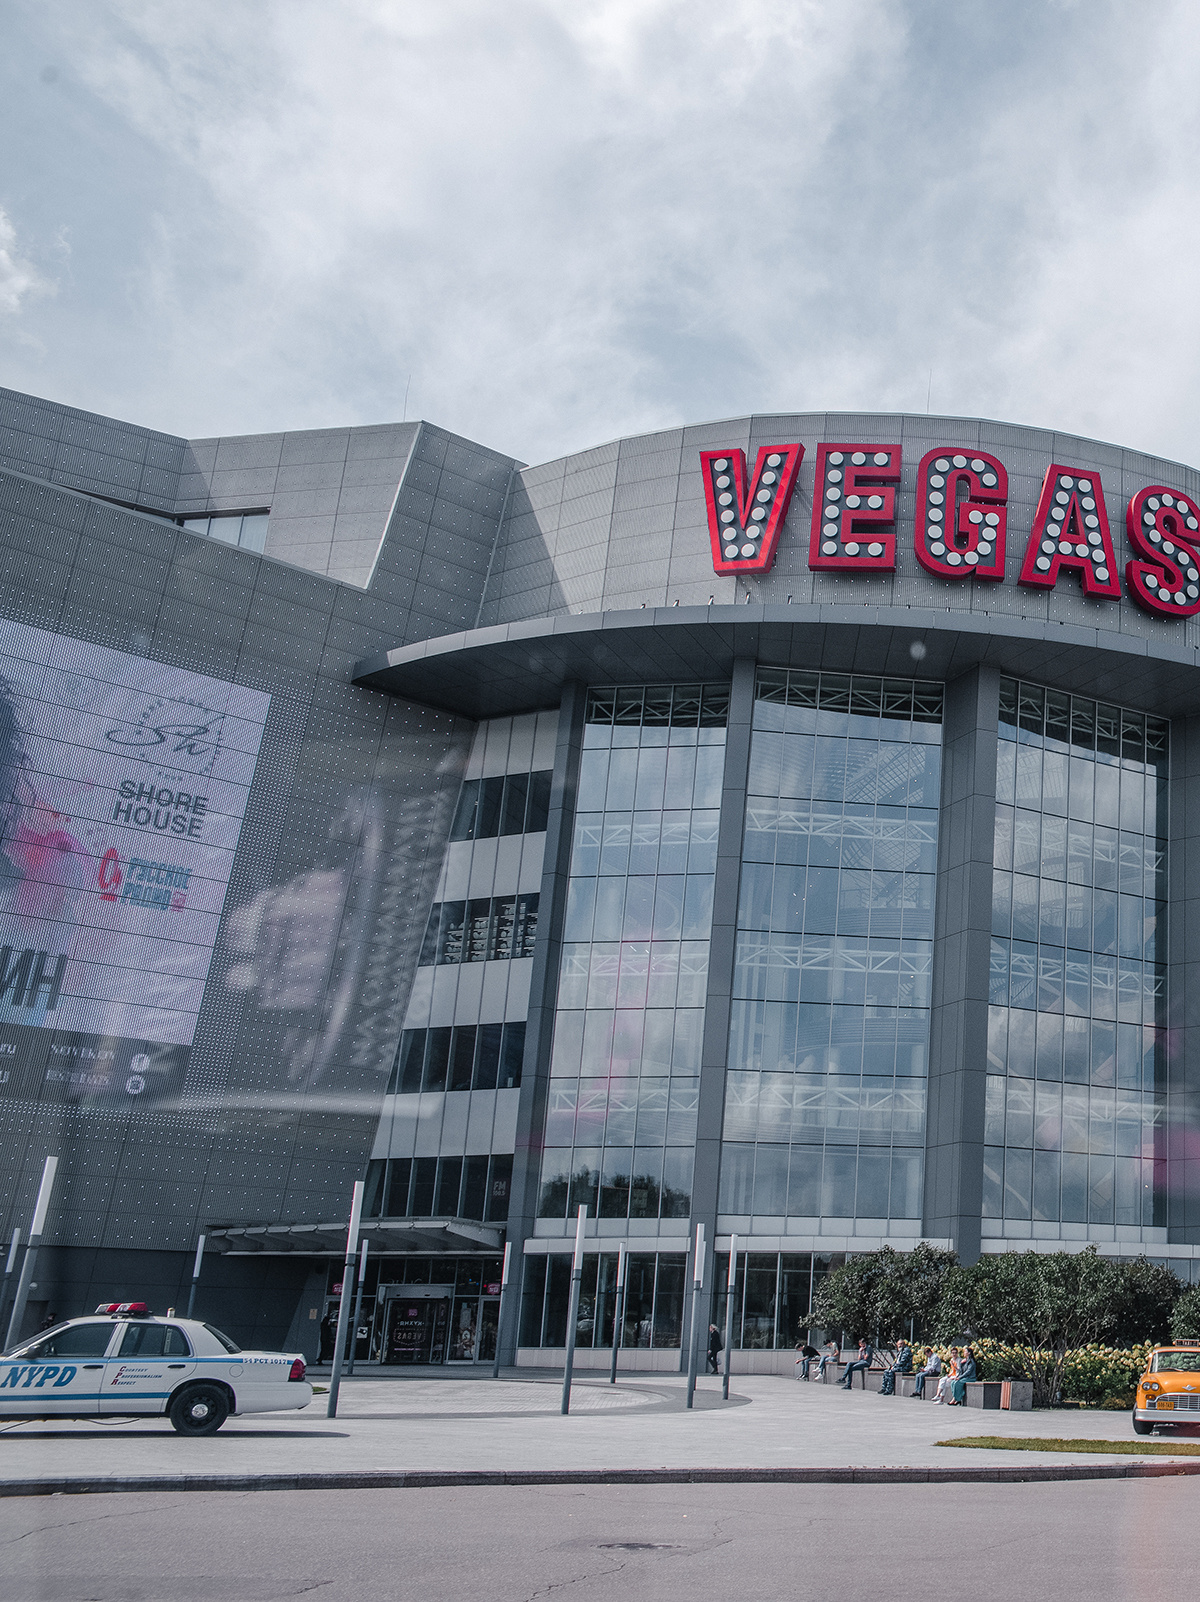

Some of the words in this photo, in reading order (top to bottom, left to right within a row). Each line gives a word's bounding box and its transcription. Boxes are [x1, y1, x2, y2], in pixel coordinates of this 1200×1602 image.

[118, 779, 209, 817] SHORE
[112, 801, 205, 839] HOUSE
[493, 1181, 507, 1190] FM
[0, 1366, 77, 1388] NYPD
